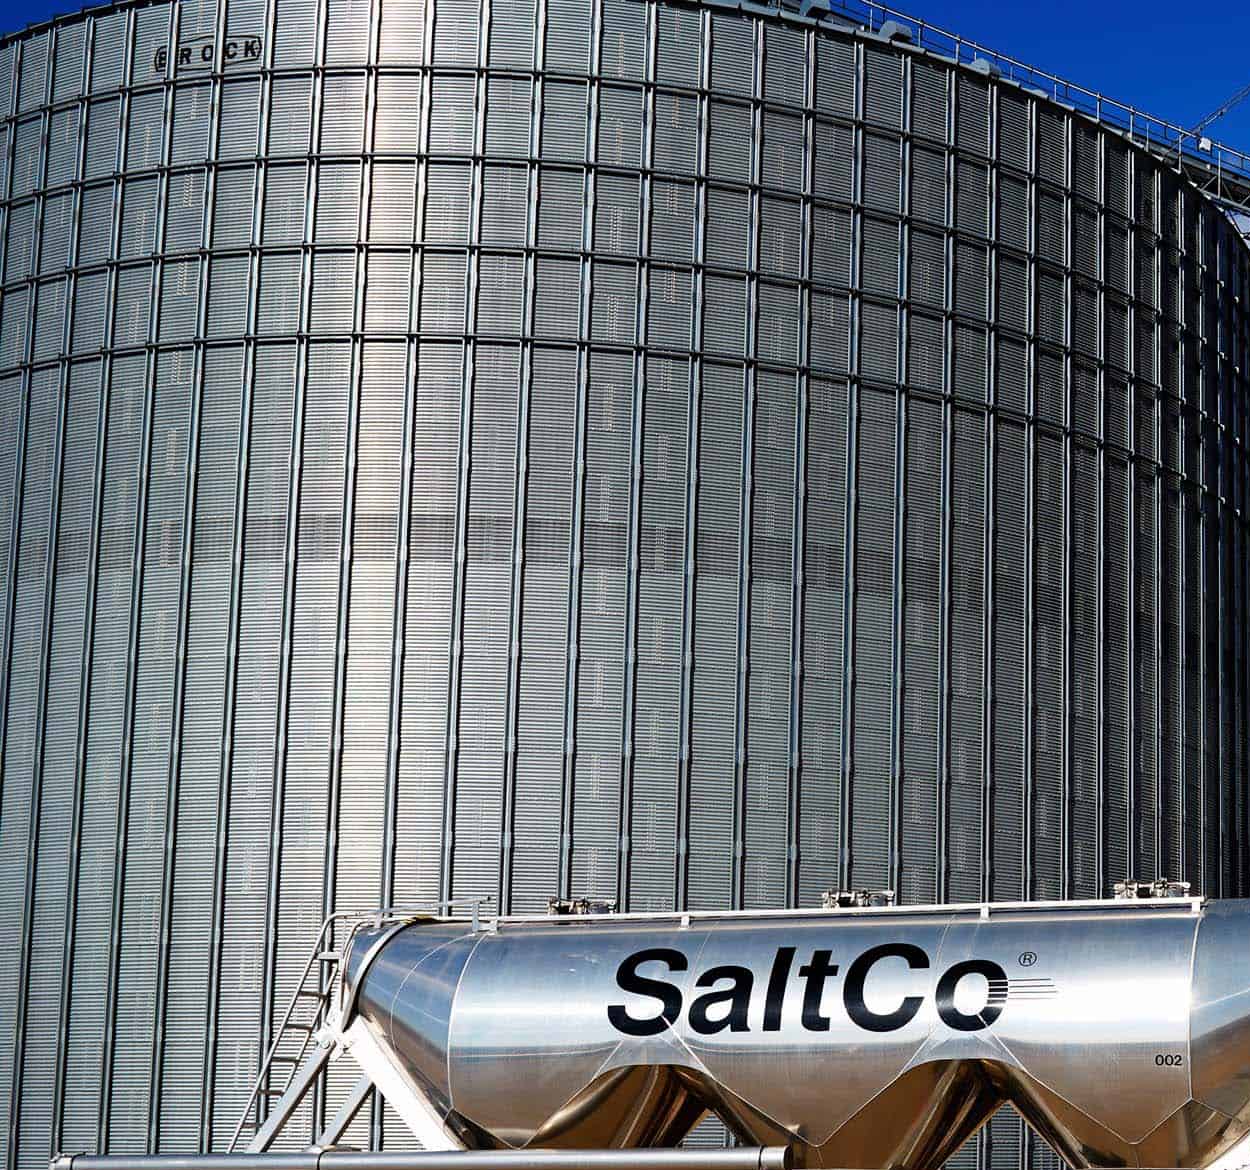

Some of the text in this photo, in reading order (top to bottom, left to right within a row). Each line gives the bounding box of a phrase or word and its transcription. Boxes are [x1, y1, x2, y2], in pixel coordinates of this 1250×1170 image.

[157, 42, 257, 68] BROCK
[607, 942, 1009, 1037] SaltCo
[1155, 1054, 1182, 1066] 002
